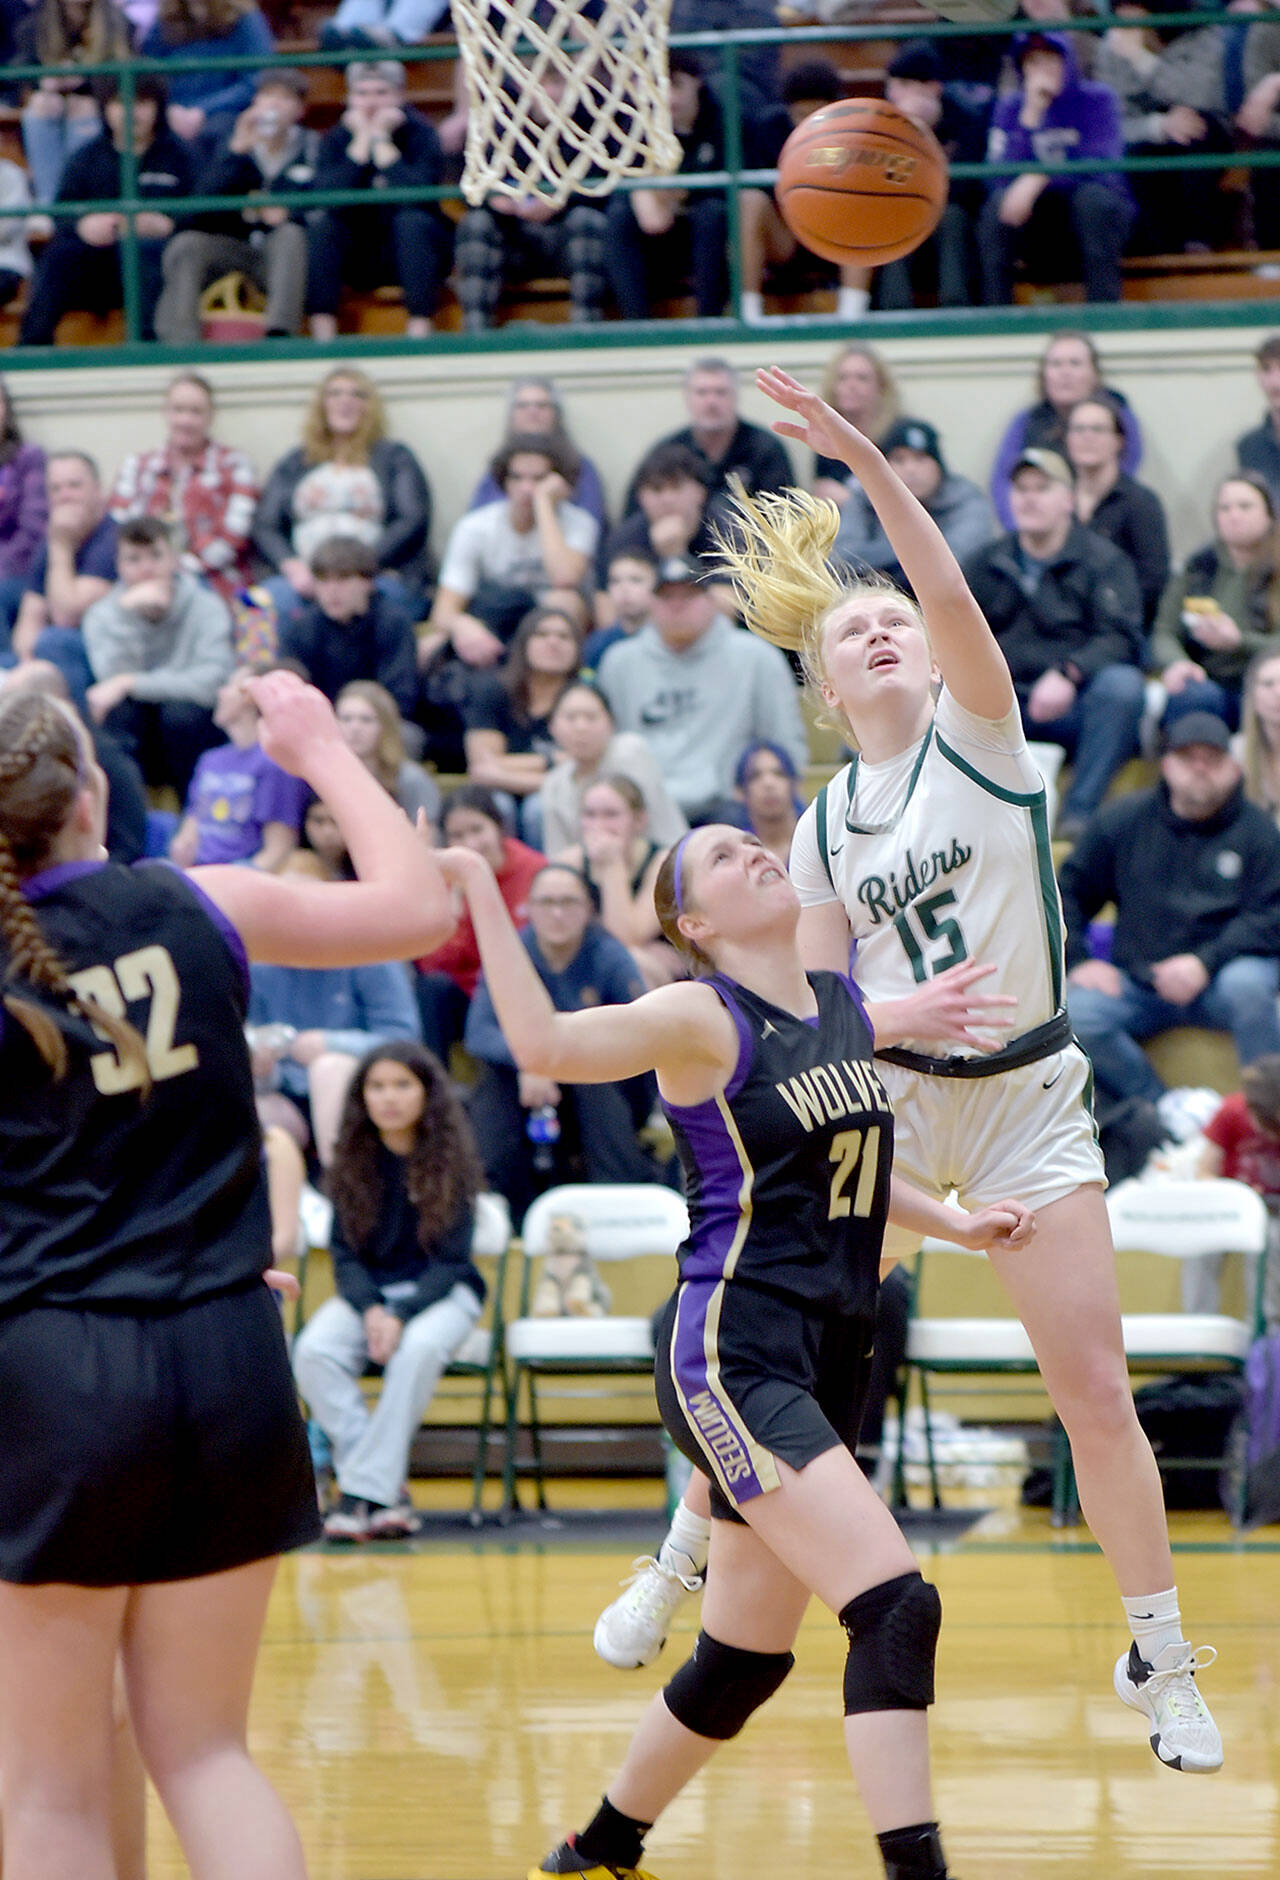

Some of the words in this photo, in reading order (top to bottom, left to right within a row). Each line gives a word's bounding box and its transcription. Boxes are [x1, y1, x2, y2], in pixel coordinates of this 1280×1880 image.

[857, 838, 972, 925] Riders
[893, 889, 968, 984] 15
[775, 1059, 894, 1133] WOLVE
[827, 1125, 881, 1222] 21
[688, 1389, 752, 1485] SEQUIM
